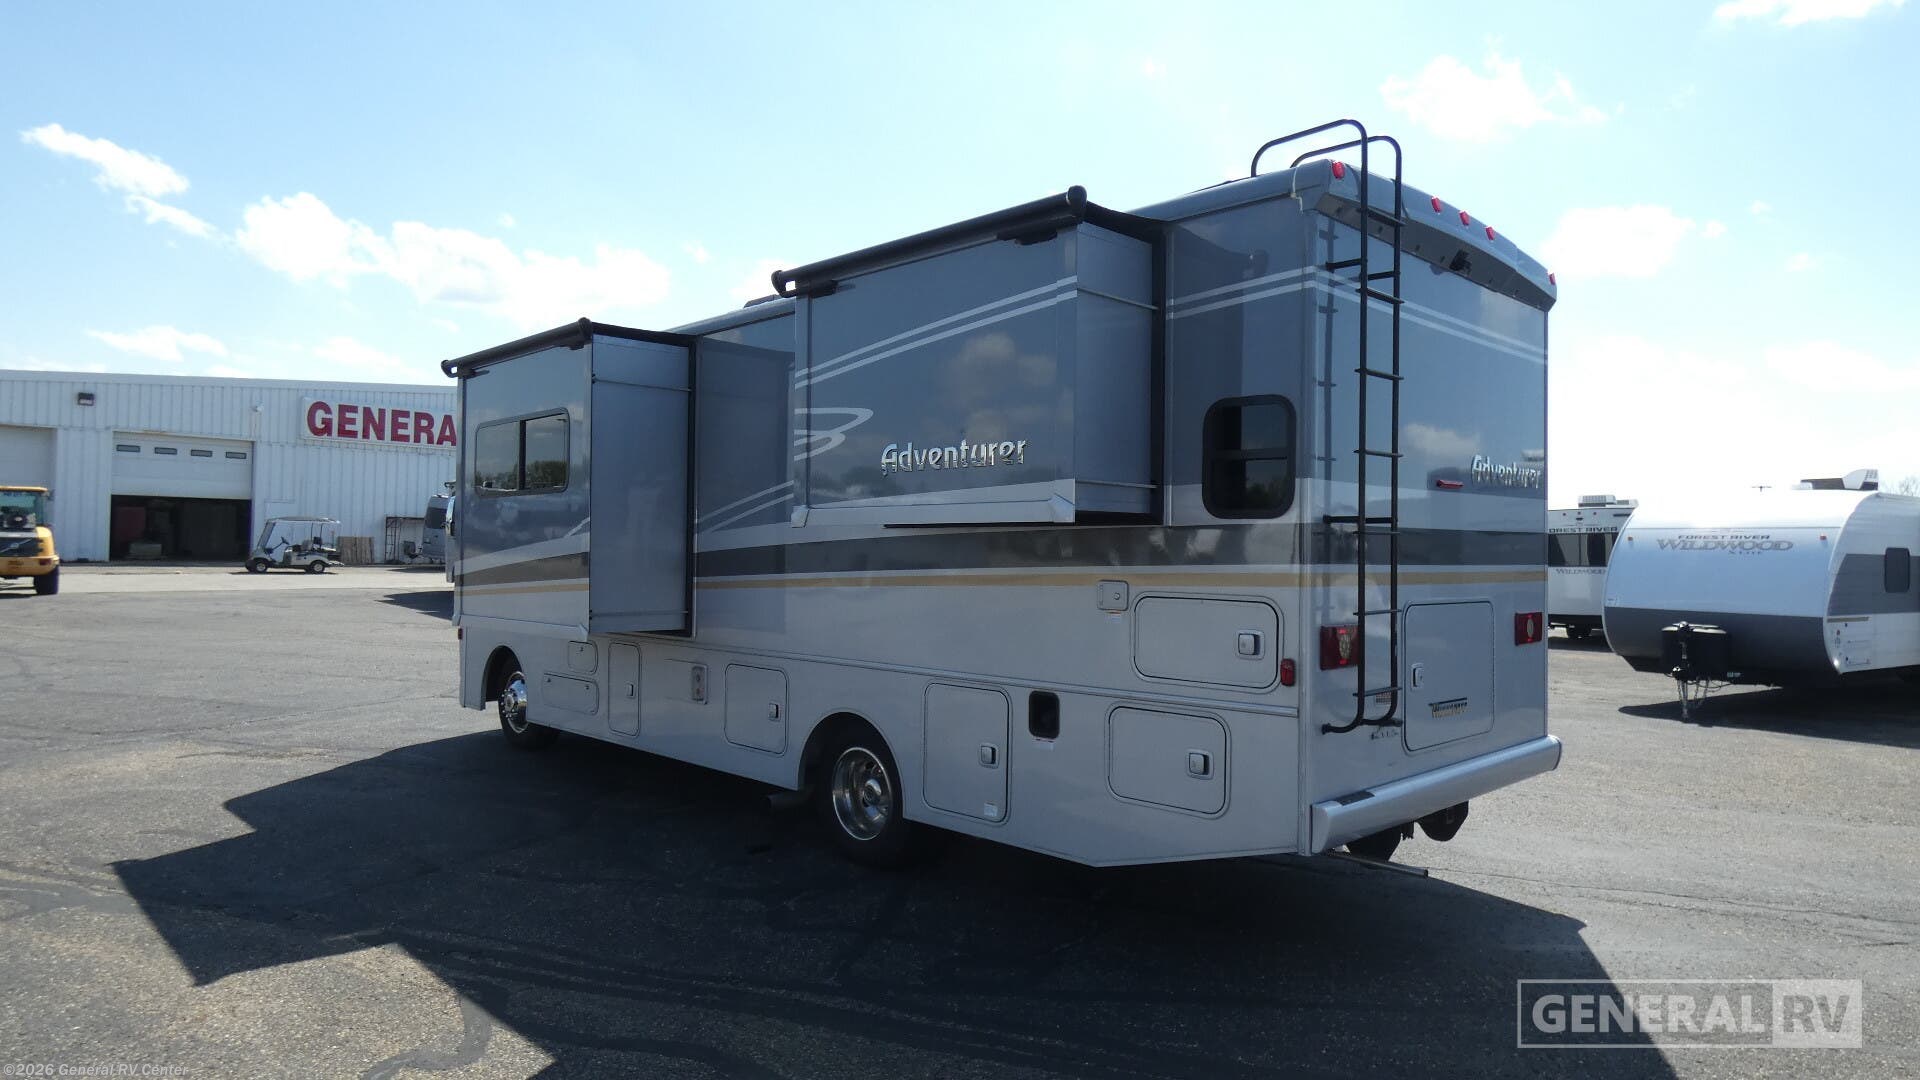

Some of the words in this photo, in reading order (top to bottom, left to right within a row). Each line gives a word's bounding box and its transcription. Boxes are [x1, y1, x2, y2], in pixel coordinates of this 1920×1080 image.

[307, 401, 457, 446] GENERA
[881, 439, 1026, 476] Adventurer
[1472, 454, 1541, 489] Adventurer
[1657, 540, 1794, 551] WILDWOOD
